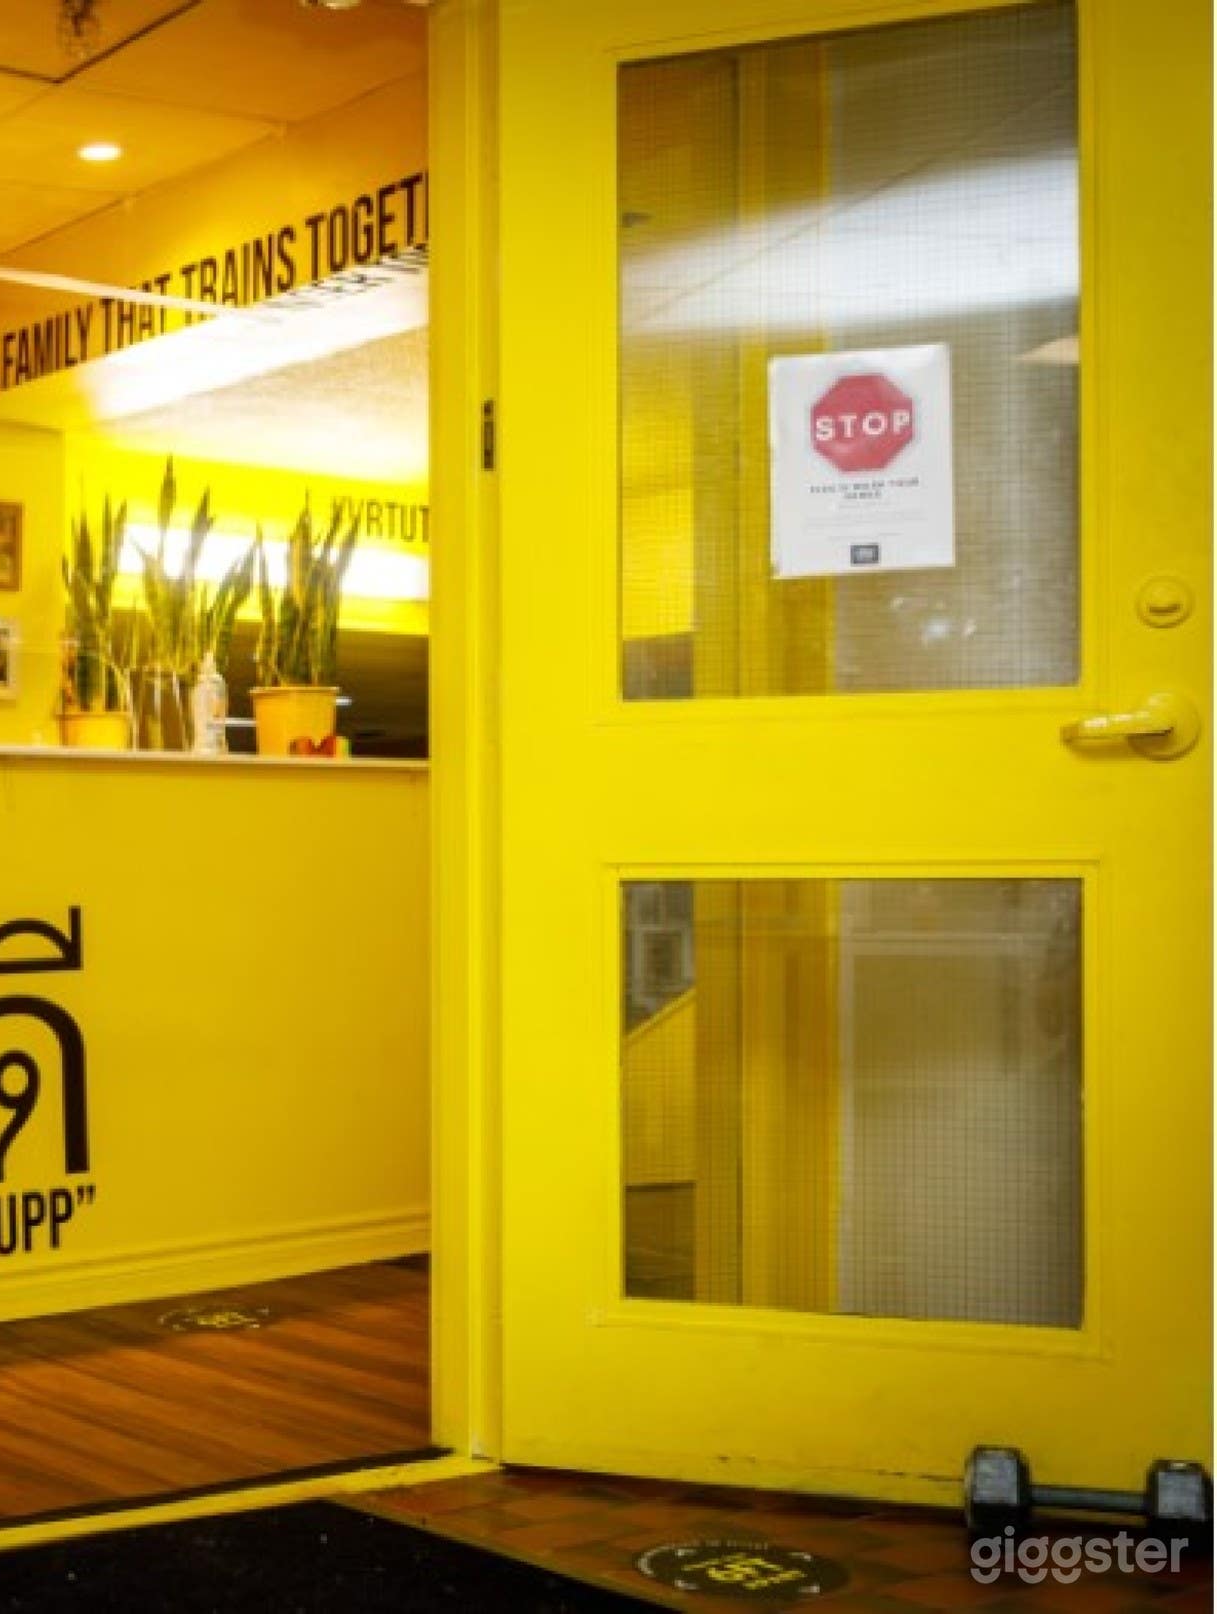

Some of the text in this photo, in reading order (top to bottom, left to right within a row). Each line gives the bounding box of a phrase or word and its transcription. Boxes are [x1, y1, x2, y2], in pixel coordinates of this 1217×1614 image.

[1, 302, 94, 390] FAMILY
[99, 273, 171, 354] THAT
[180, 225, 297, 326] TRAINS
[305, 171, 429, 286] TOGET
[815, 408, 911, 442] STOP
